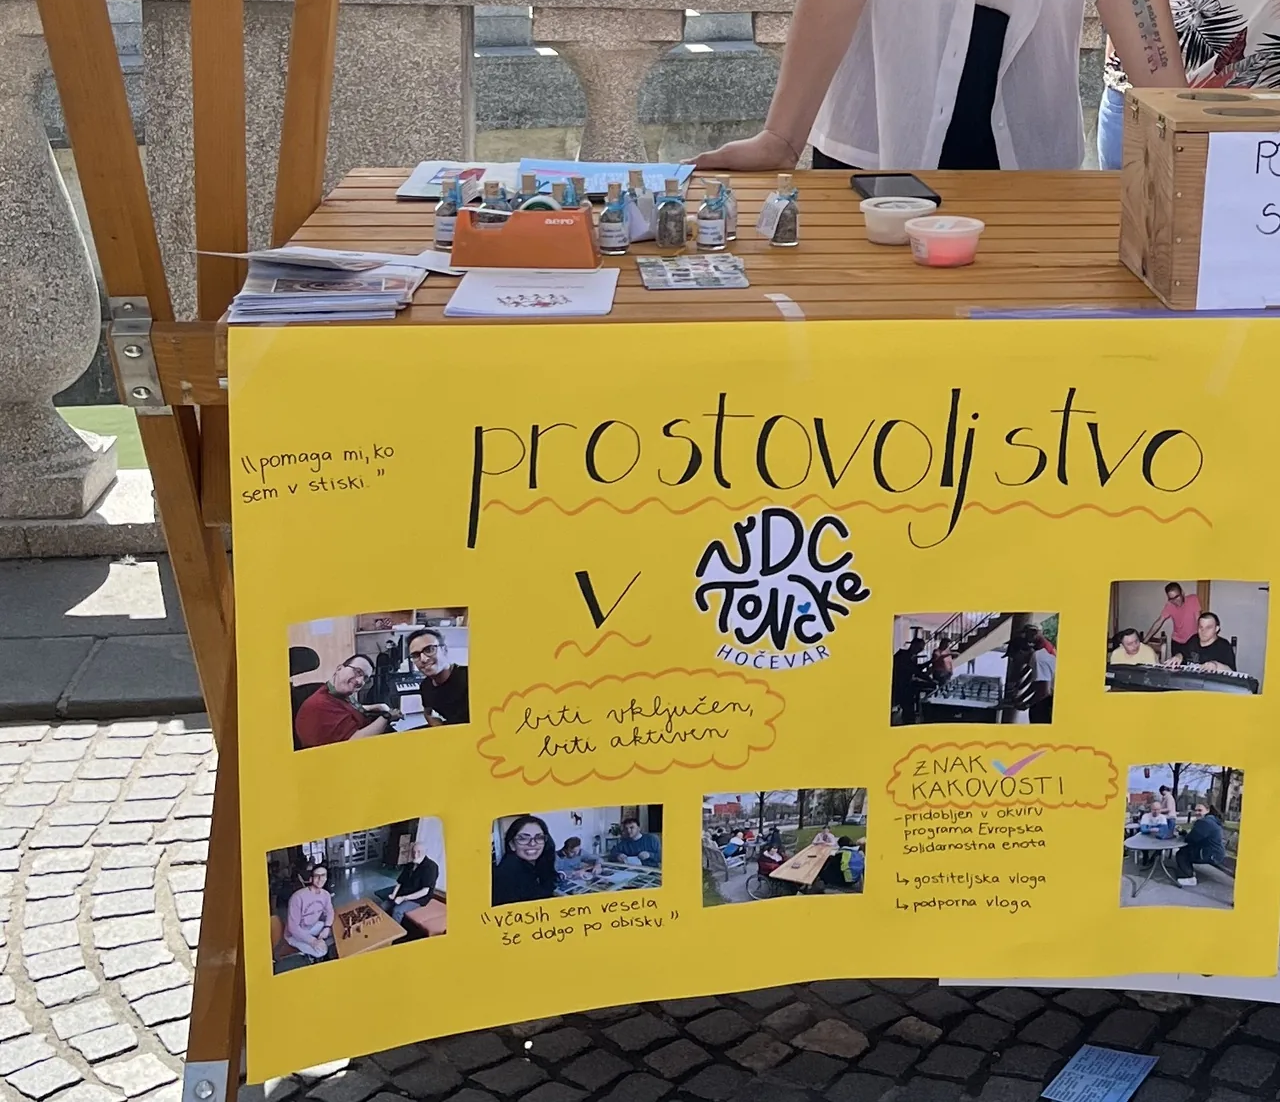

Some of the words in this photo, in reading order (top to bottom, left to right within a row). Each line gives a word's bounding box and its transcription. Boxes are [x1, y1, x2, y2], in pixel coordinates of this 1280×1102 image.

[467, 388, 1204, 549] prostovoljstvo
[242, 487, 278, 503] sem
[288, 483, 298, 494] v
[716, 644, 830, 670] HOČEVAR
[610, 726, 729, 748] aktiven
[913, 755, 988, 777] ZNAK
[912, 776, 1064, 800] KAKOVOSTI
[997, 805, 1043, 818] okviru
[904, 825, 973, 840] programa
[978, 822, 1044, 838] Evropska
[903, 841, 996, 855] solidarnostna
[1002, 838, 1046, 849] enota
[914, 872, 1000, 889] gostiteljska
[1009, 872, 1046, 889] vloga
[560, 906, 592, 918] sem
[601, 897, 658, 914] vesela
[913, 897, 977, 913] podporna
[986, 895, 1032, 914] vloga
[584, 921, 602, 936] po
